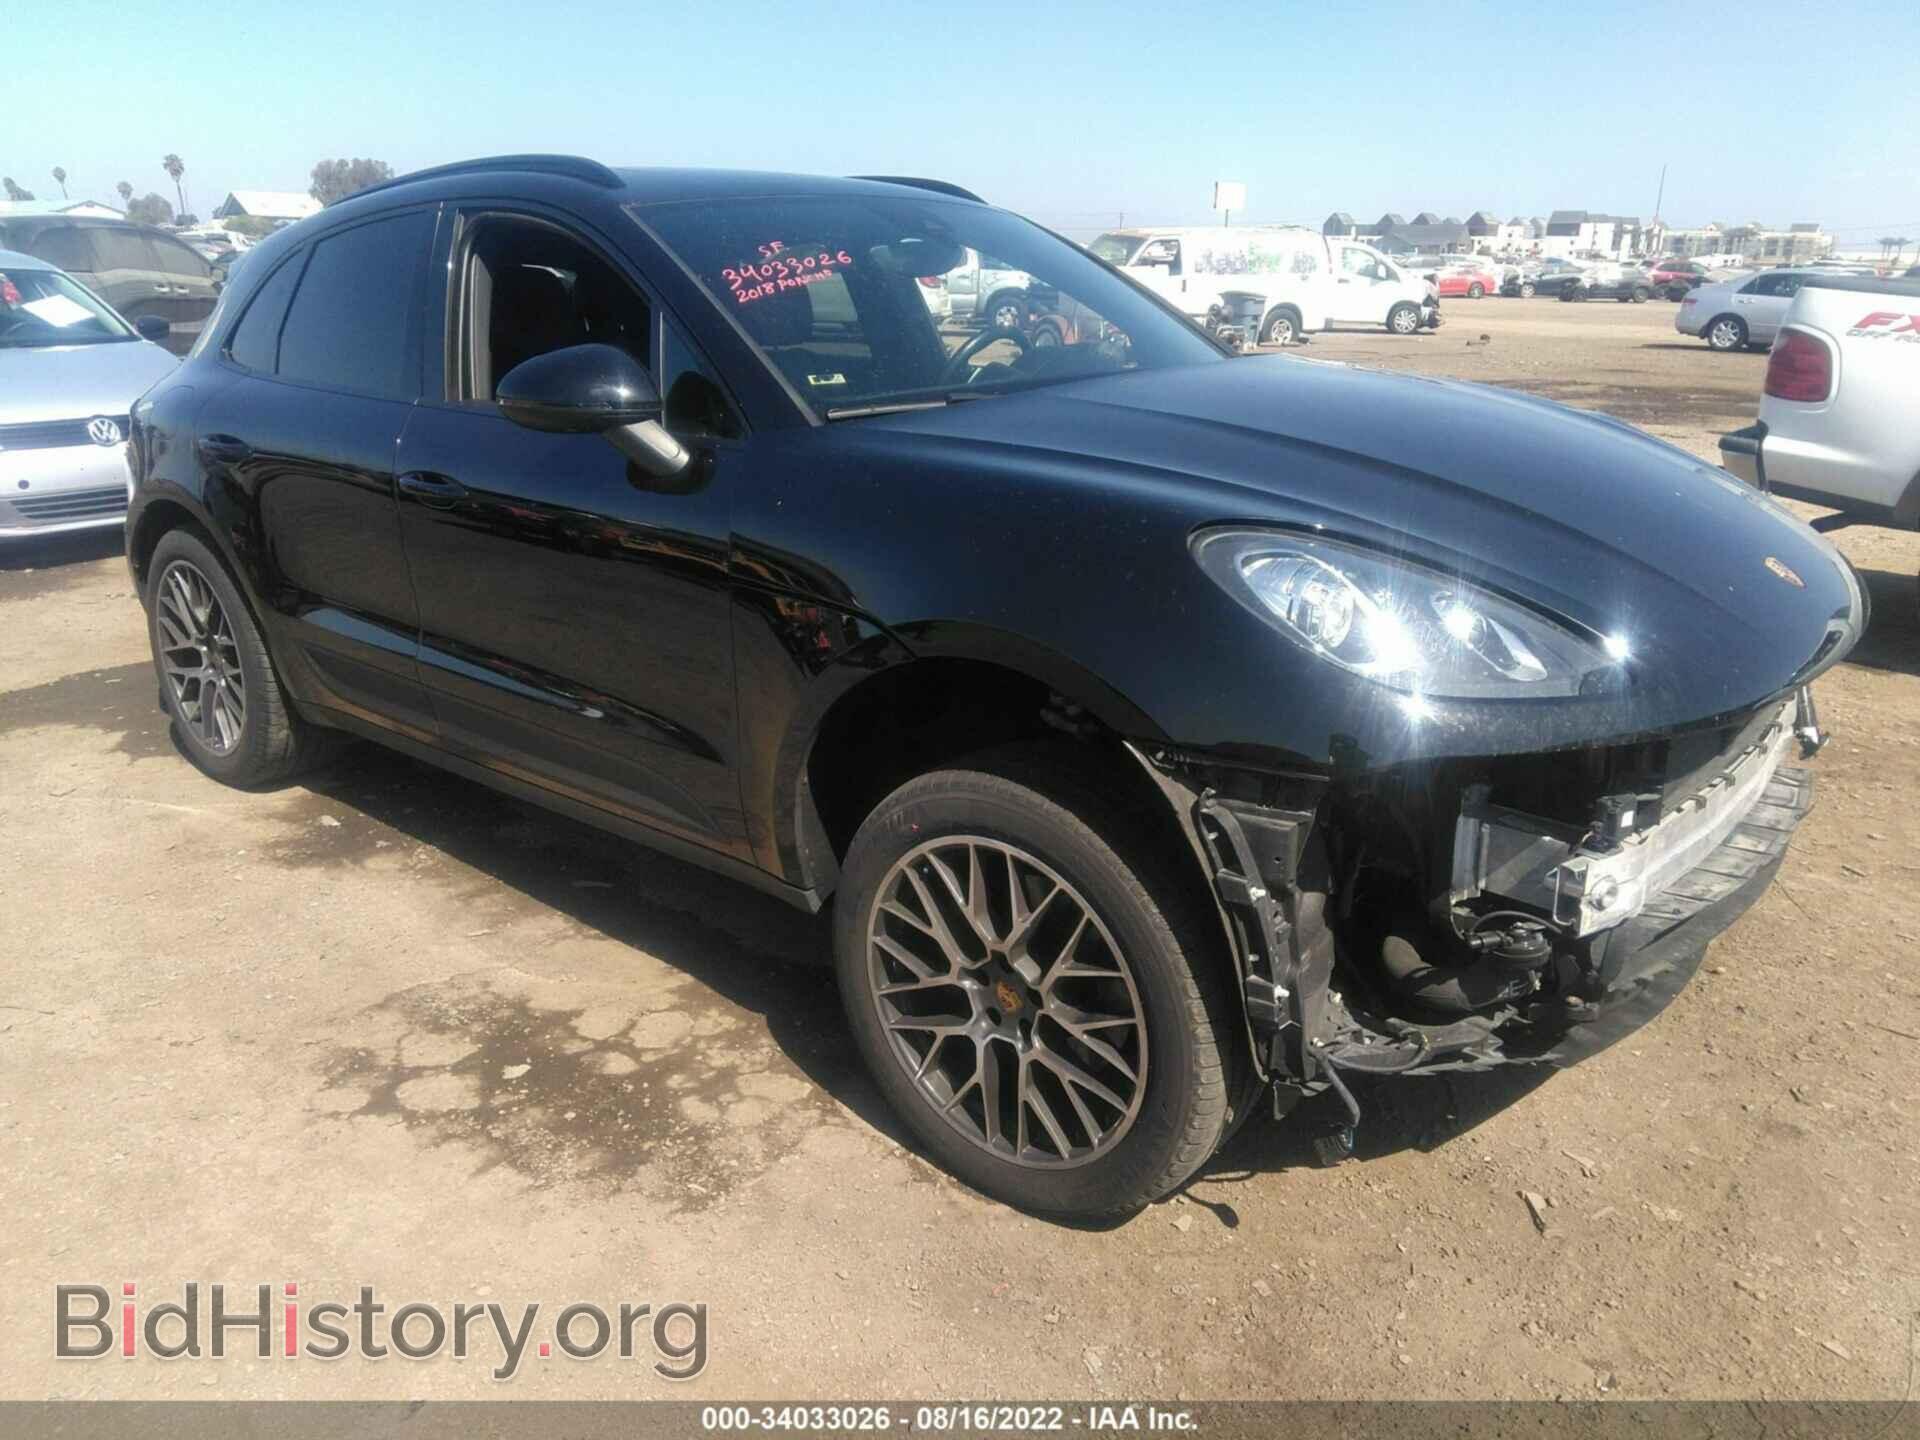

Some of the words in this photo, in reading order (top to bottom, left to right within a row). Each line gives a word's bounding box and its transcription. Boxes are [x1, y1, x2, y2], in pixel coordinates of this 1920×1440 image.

[757, 240, 785, 258] SF
[722, 250, 852, 290] 34033026
[736, 282, 775, 303] 2018
